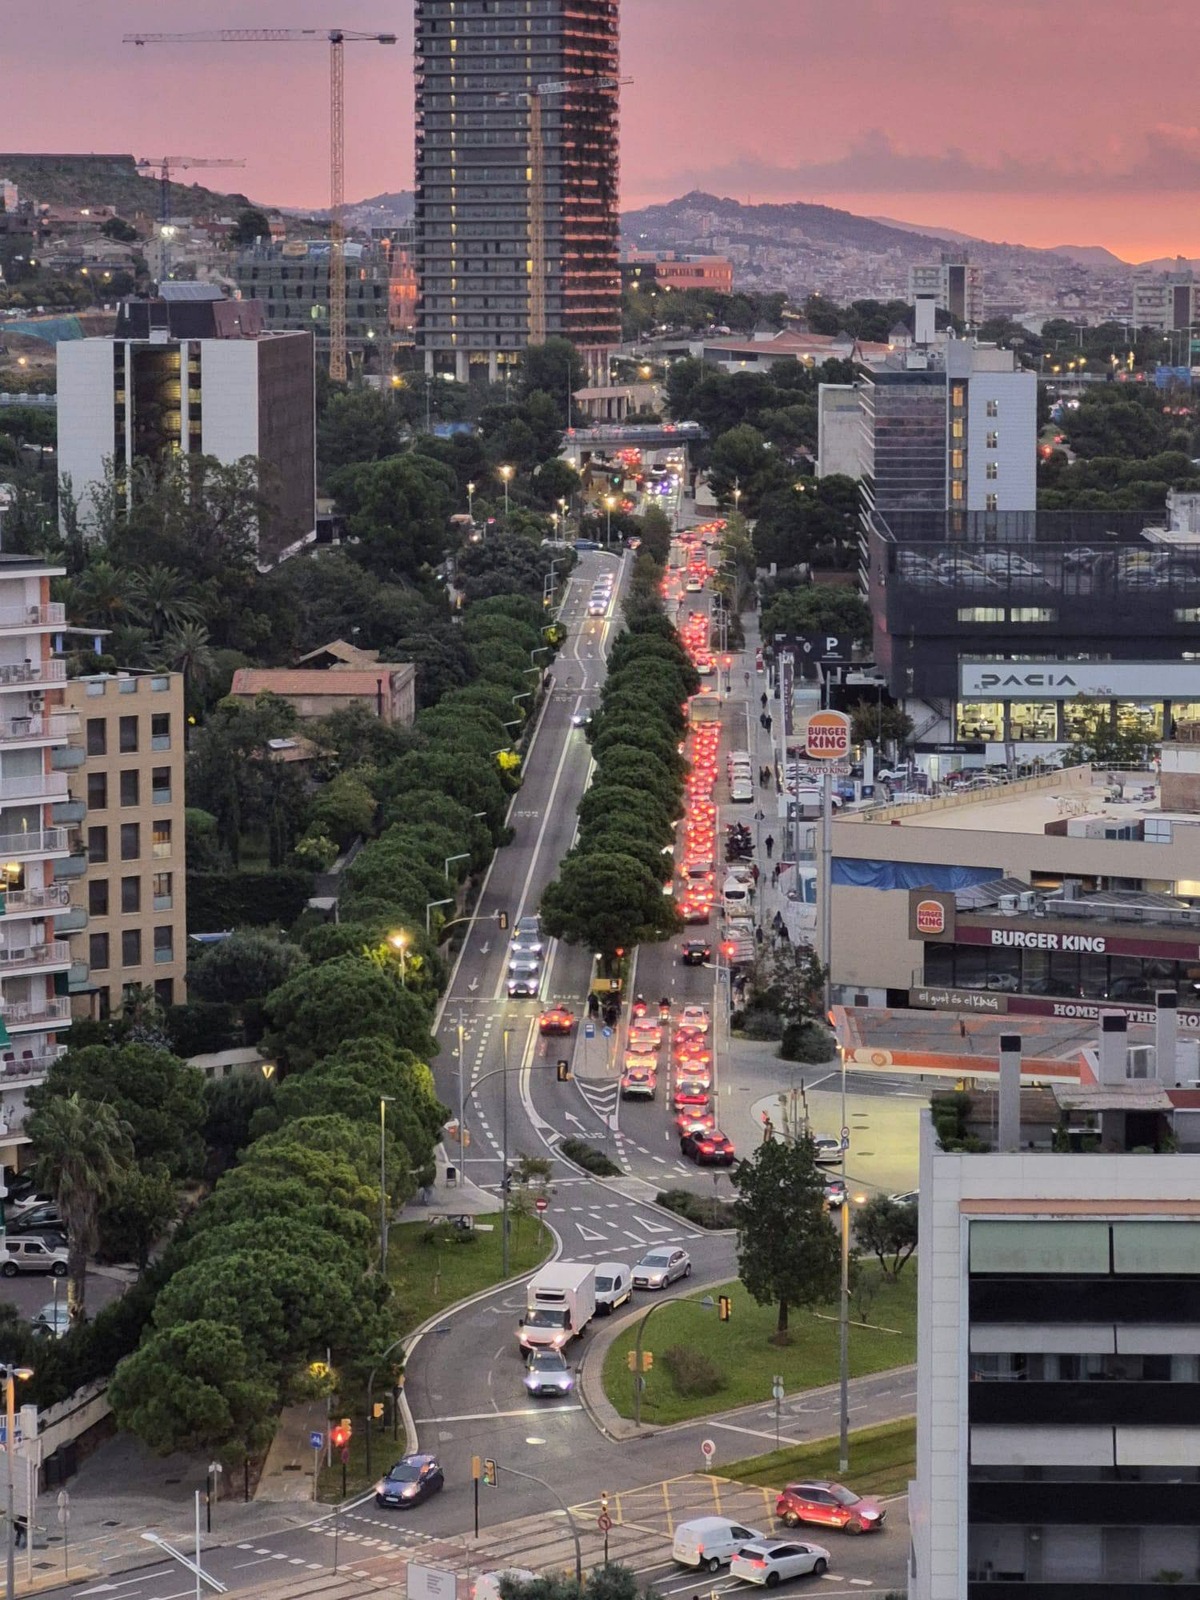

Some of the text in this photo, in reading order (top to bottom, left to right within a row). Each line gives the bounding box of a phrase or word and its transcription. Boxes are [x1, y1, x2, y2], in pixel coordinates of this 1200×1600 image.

[826, 637, 839, 651] P
[808, 726, 847, 736] BURGER
[808, 735, 847, 749] KING
[918, 910, 943, 918] BURGER
[918, 917, 943, 927] KING
[991, 929, 1106, 953] BURGER KING
[1053, 1004, 1099, 1019] HOME
[1177, 1014, 1200, 1028] HO
